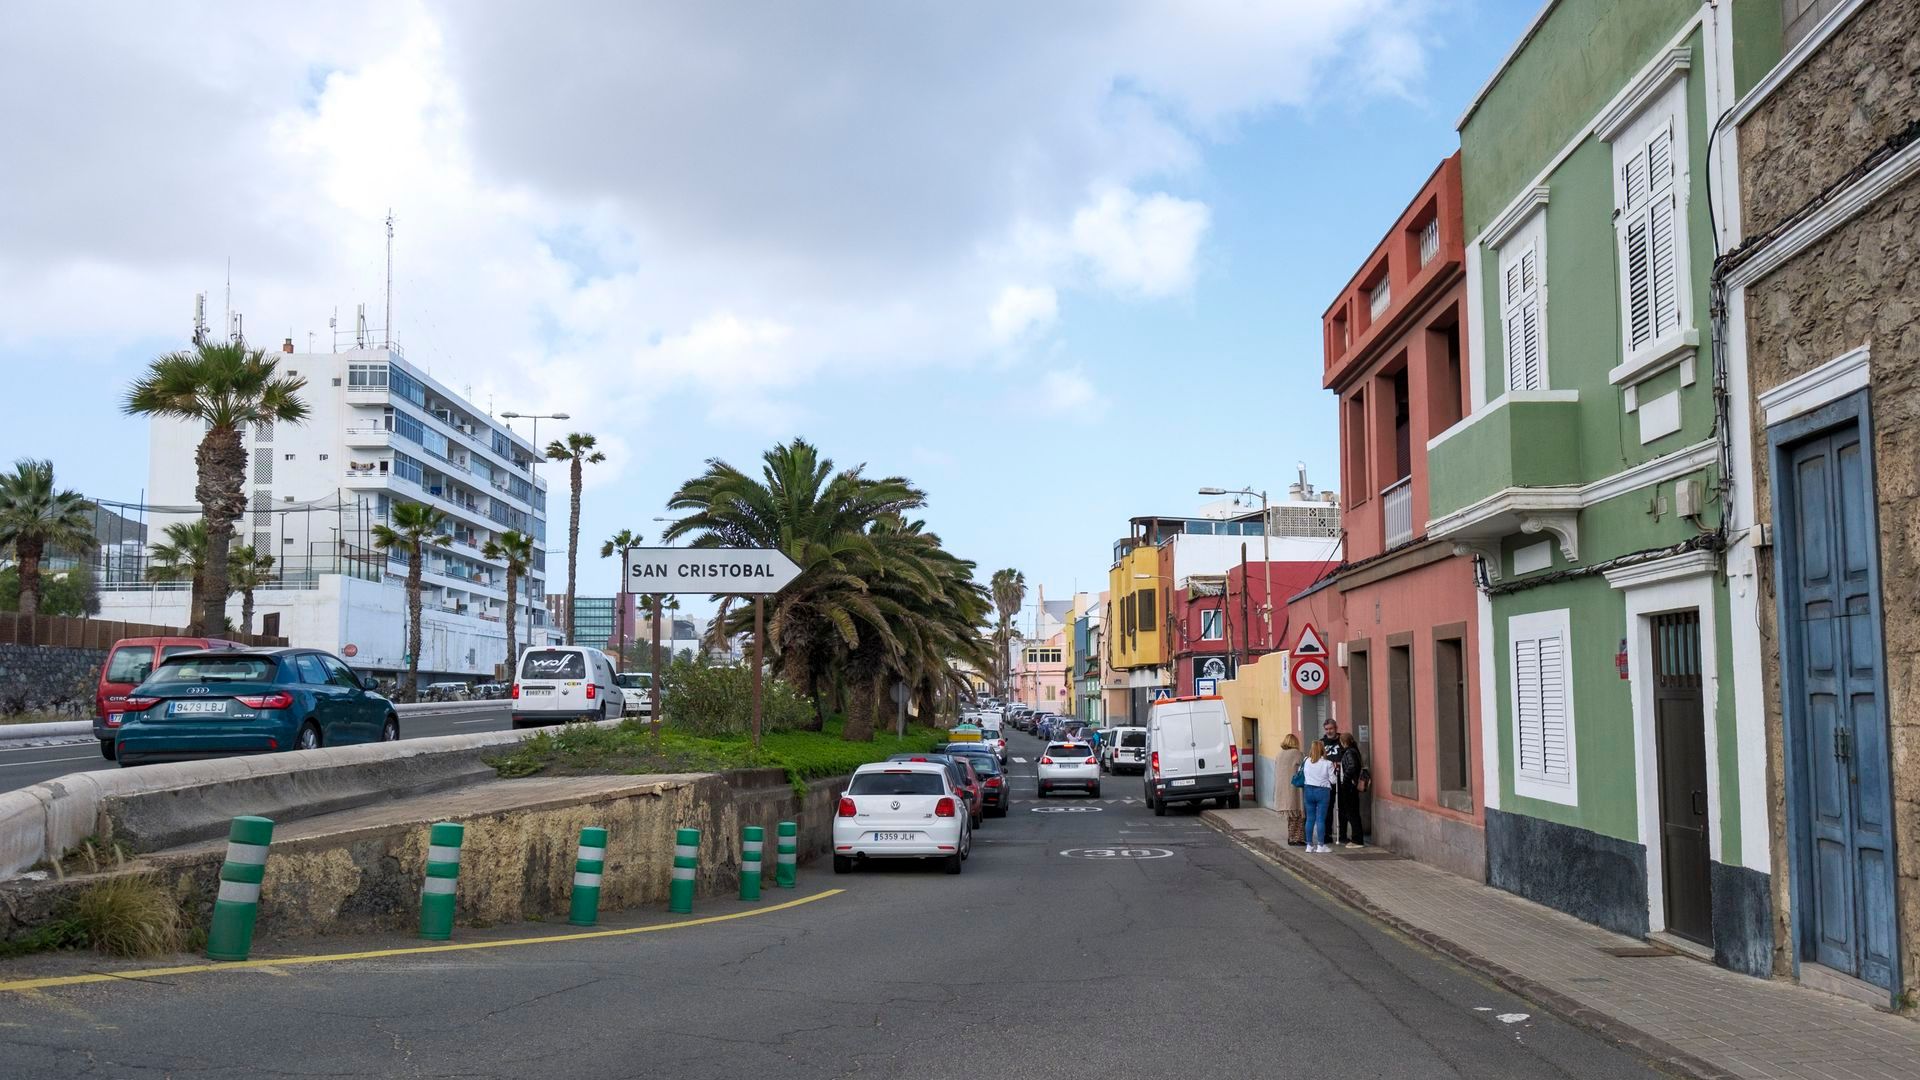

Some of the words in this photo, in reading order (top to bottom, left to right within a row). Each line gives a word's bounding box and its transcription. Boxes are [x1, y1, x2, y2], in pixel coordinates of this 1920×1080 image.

[631, 563, 668, 578] SAN
[677, 563, 775, 578] CRISTOBAL
[1300, 669, 1321, 682] 30
[176, 702, 202, 712] 9479
[204, 702, 225, 712] LBJ
[879, 833, 898, 841] 5359
[900, 833, 914, 841] JLH
[1083, 849, 1151, 858] 30
